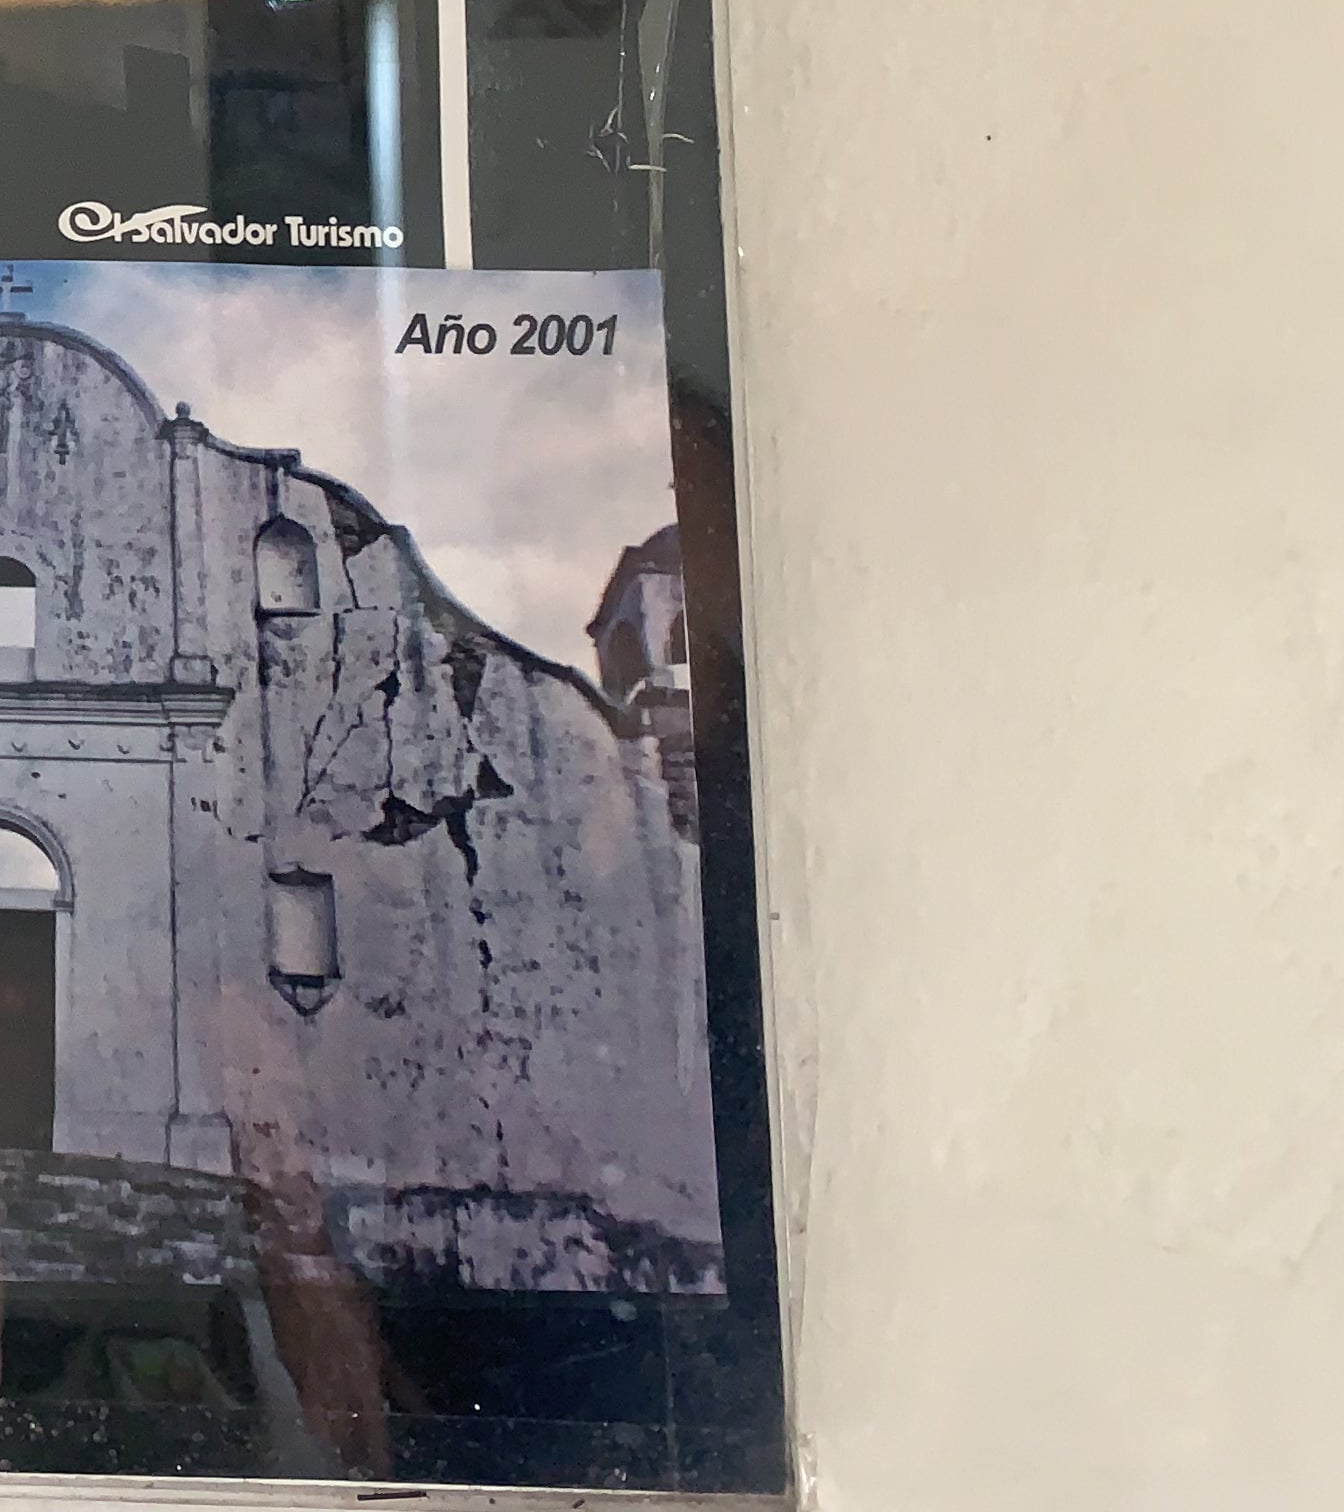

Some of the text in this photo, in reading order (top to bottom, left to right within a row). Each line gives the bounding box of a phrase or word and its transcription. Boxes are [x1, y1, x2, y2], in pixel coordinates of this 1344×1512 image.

[284, 215, 405, 248] Turismo
[394, 313, 618, 356] Año 2001
